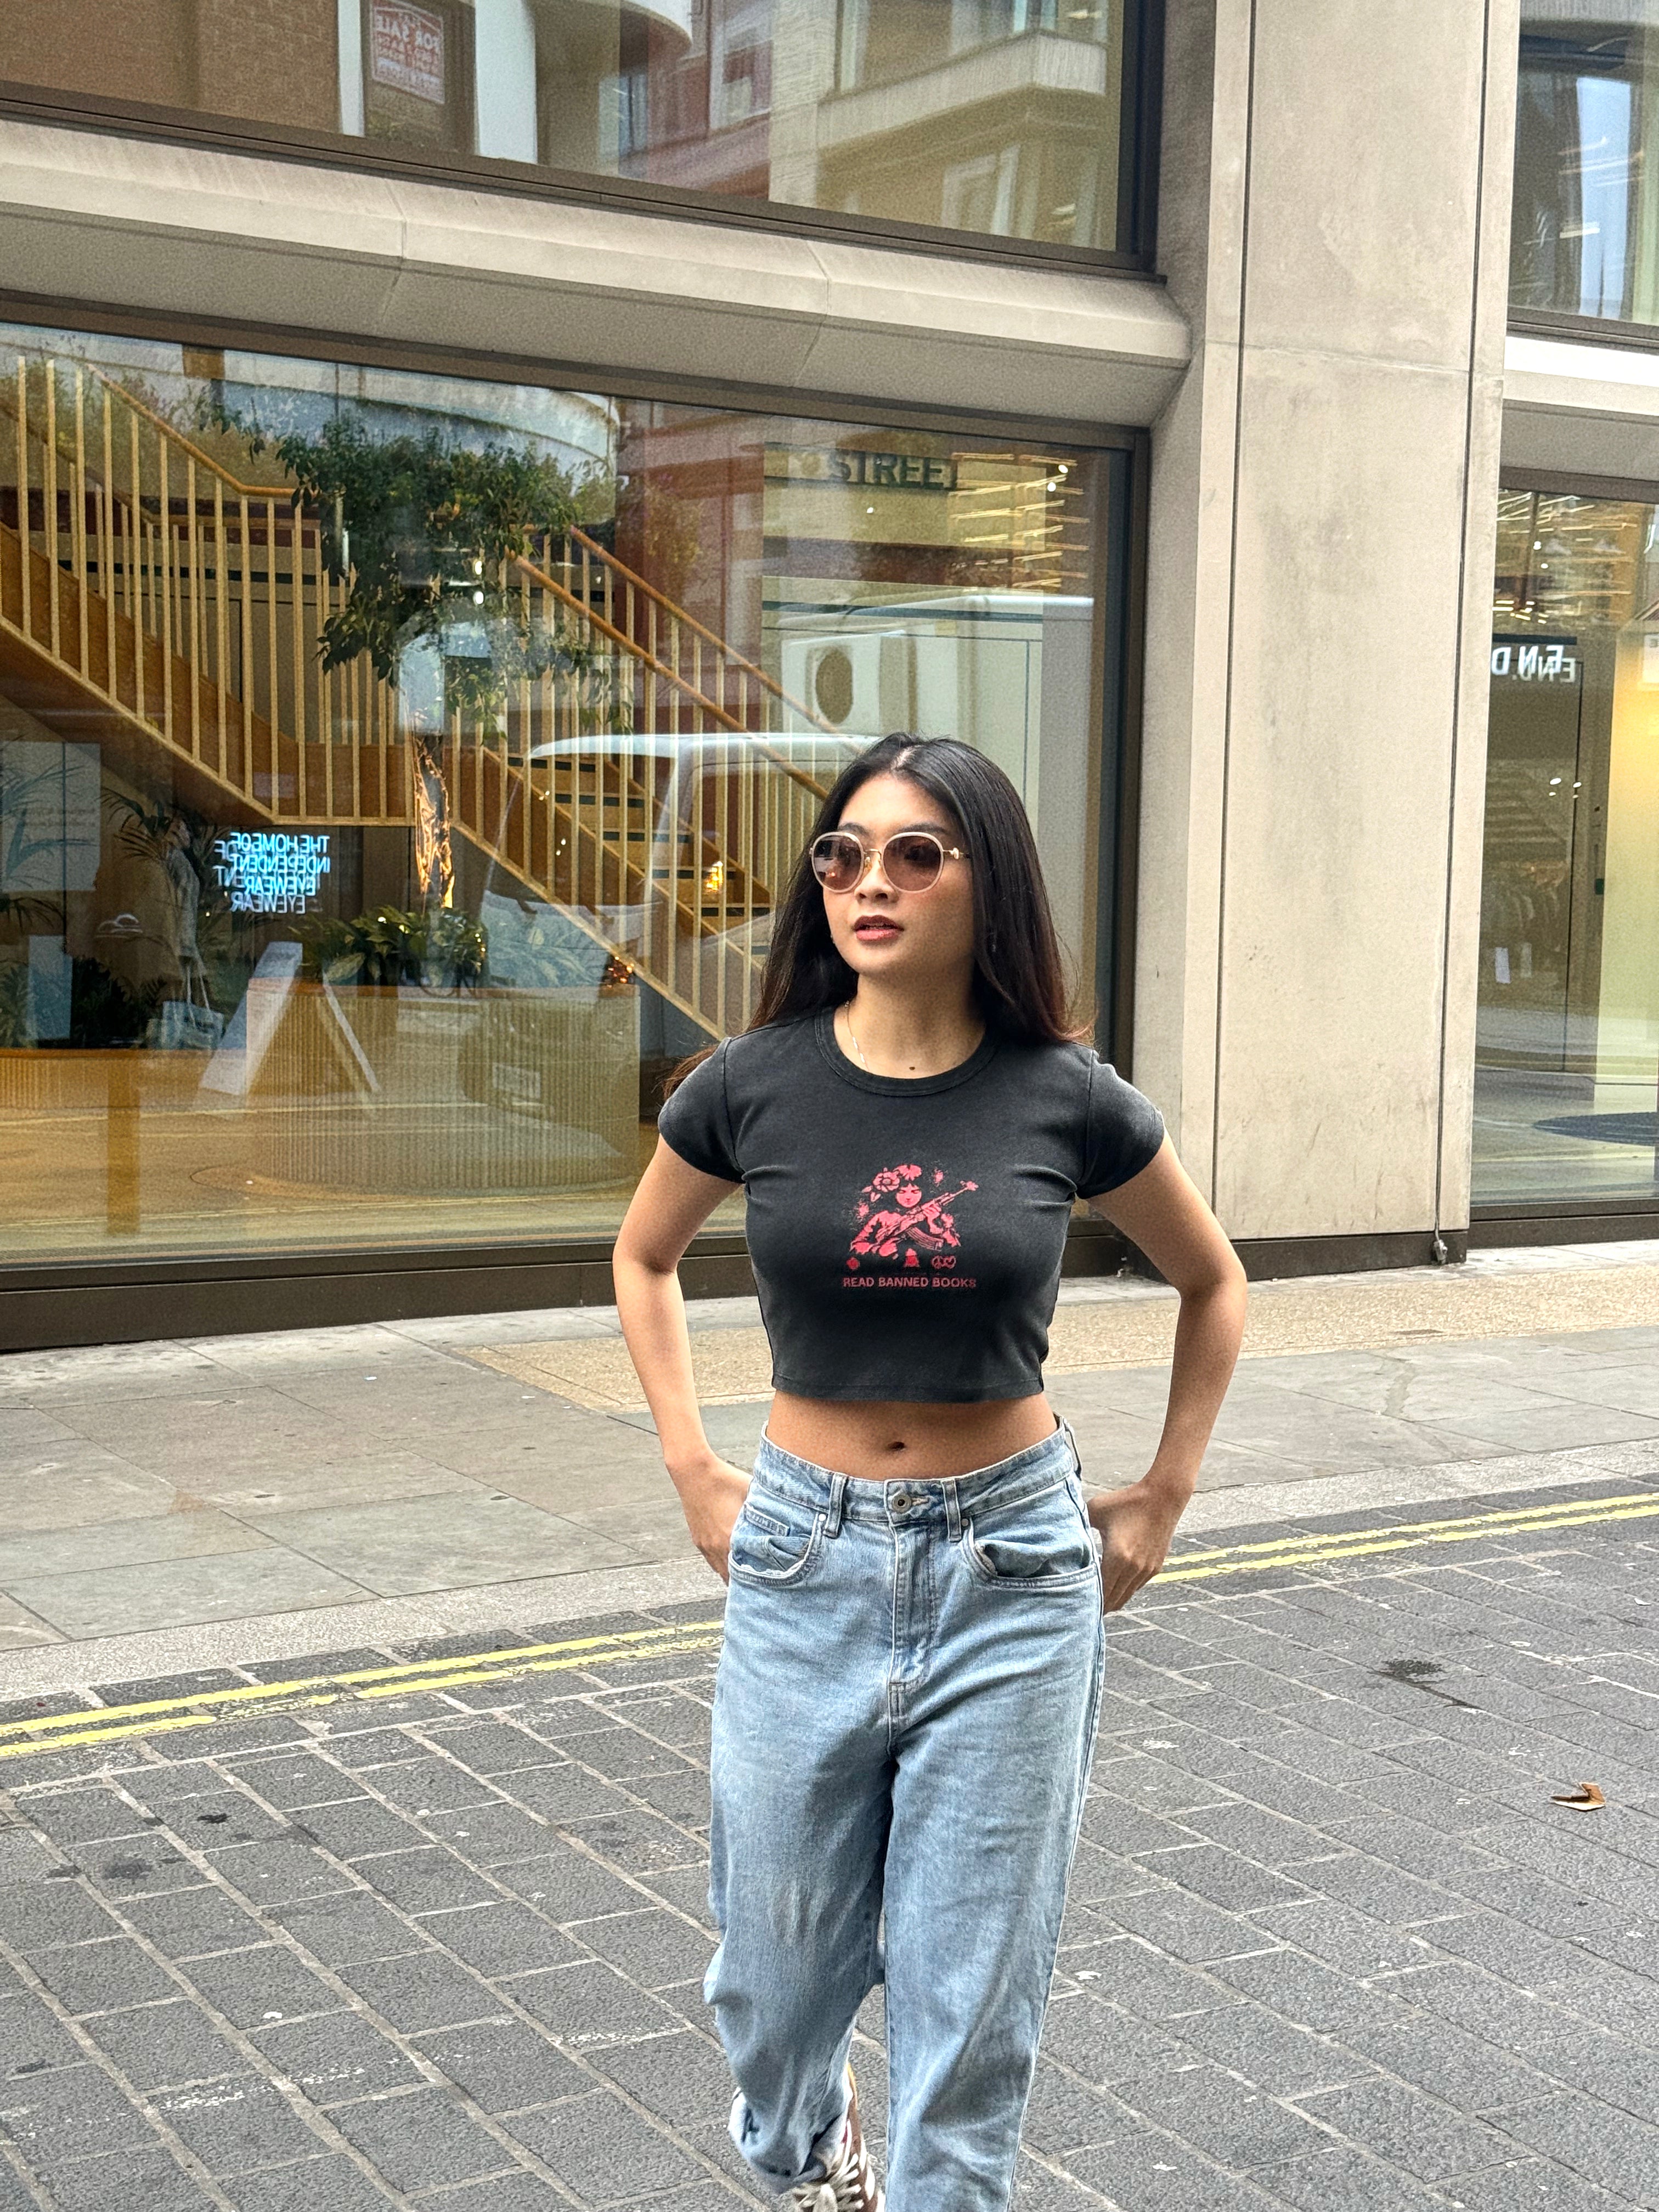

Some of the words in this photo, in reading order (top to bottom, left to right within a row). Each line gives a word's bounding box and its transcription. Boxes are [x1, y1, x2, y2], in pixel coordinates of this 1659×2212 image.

[843, 1277, 874, 1287] READ
[878, 1277, 929, 1287] BANNED
[932, 1277, 977, 1288] BOOKS
